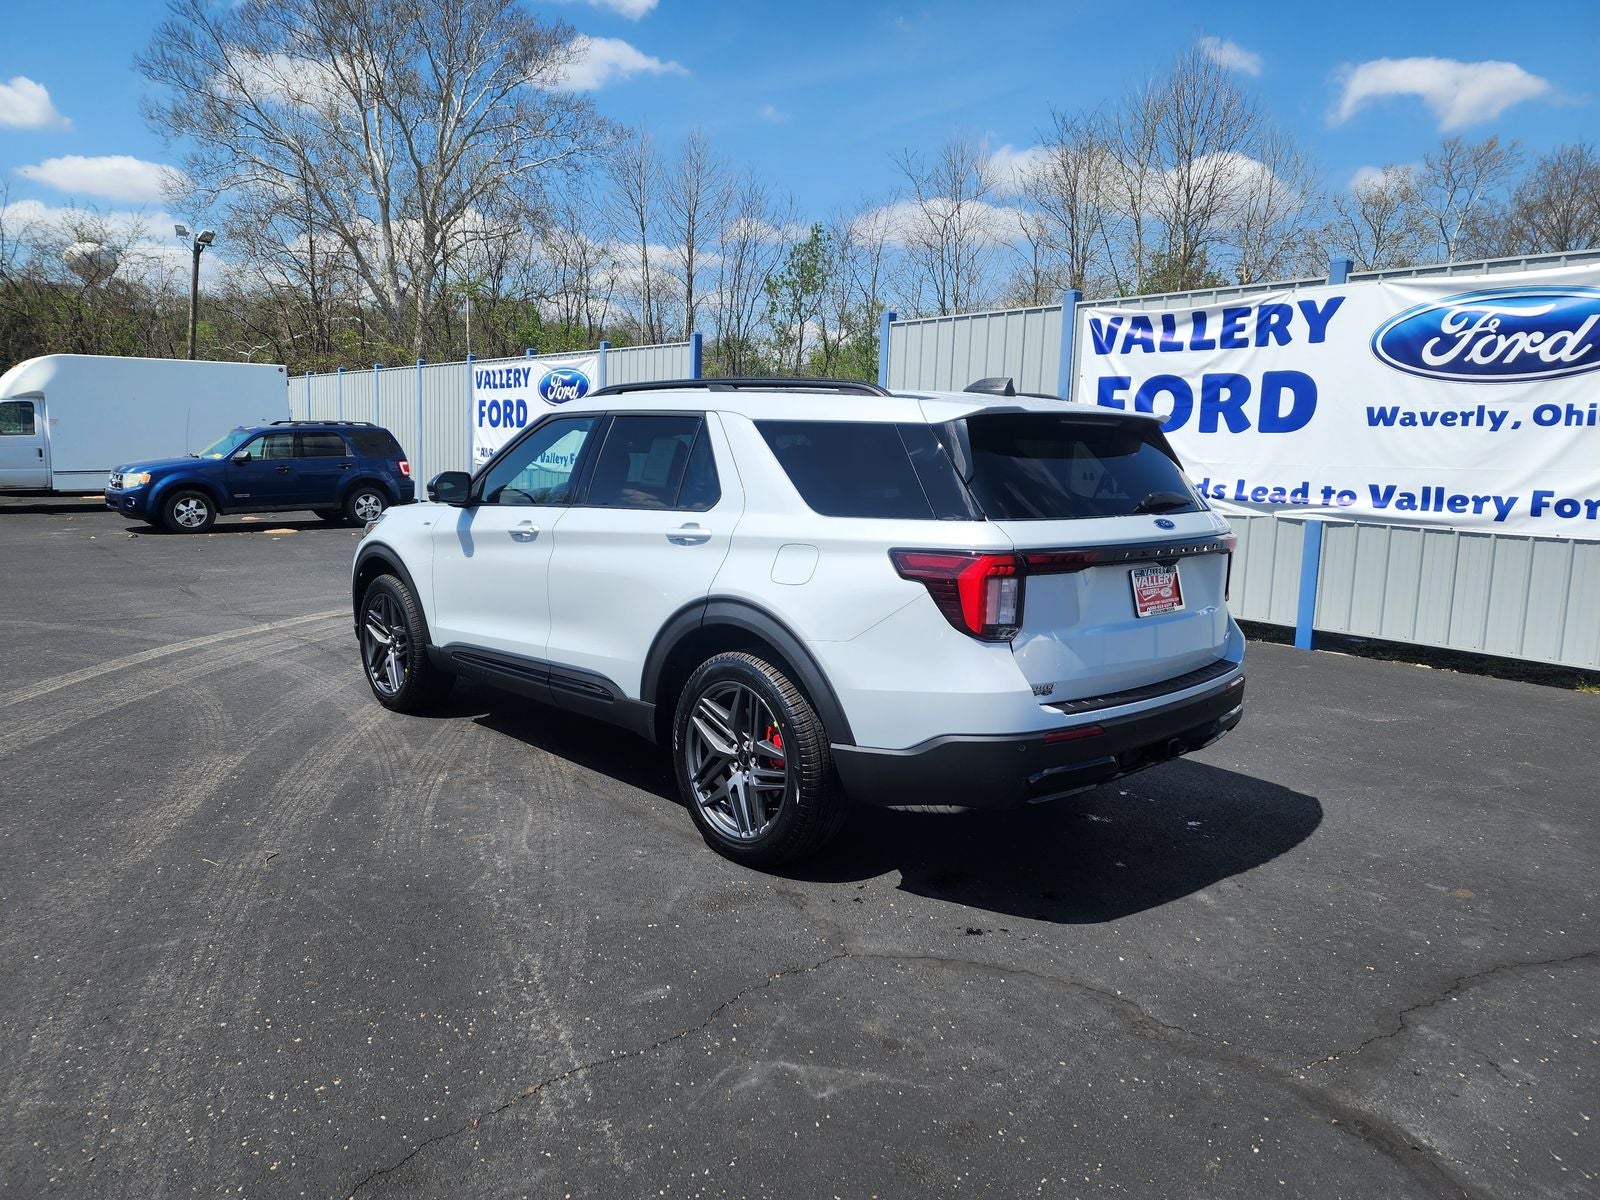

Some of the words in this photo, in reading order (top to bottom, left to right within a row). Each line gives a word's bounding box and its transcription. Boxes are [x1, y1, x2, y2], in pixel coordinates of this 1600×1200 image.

[1089, 296, 1346, 355] VALLERY
[1421, 303, 1600, 366] Ford
[475, 367, 531, 389] VALLERY
[547, 373, 580, 400] Ford
[478, 399, 528, 428] FORD
[1097, 370, 1318, 433] FORD
[1366, 404, 1522, 432] Waverly,
[1532, 402, 1600, 427] Ohi
[1234, 479, 1310, 505] Lead
[1320, 485, 1357, 507] to
[1368, 484, 1519, 522] Vallery
[1530, 490, 1600, 520] For
[1135, 572, 1176, 588] VALLERY
